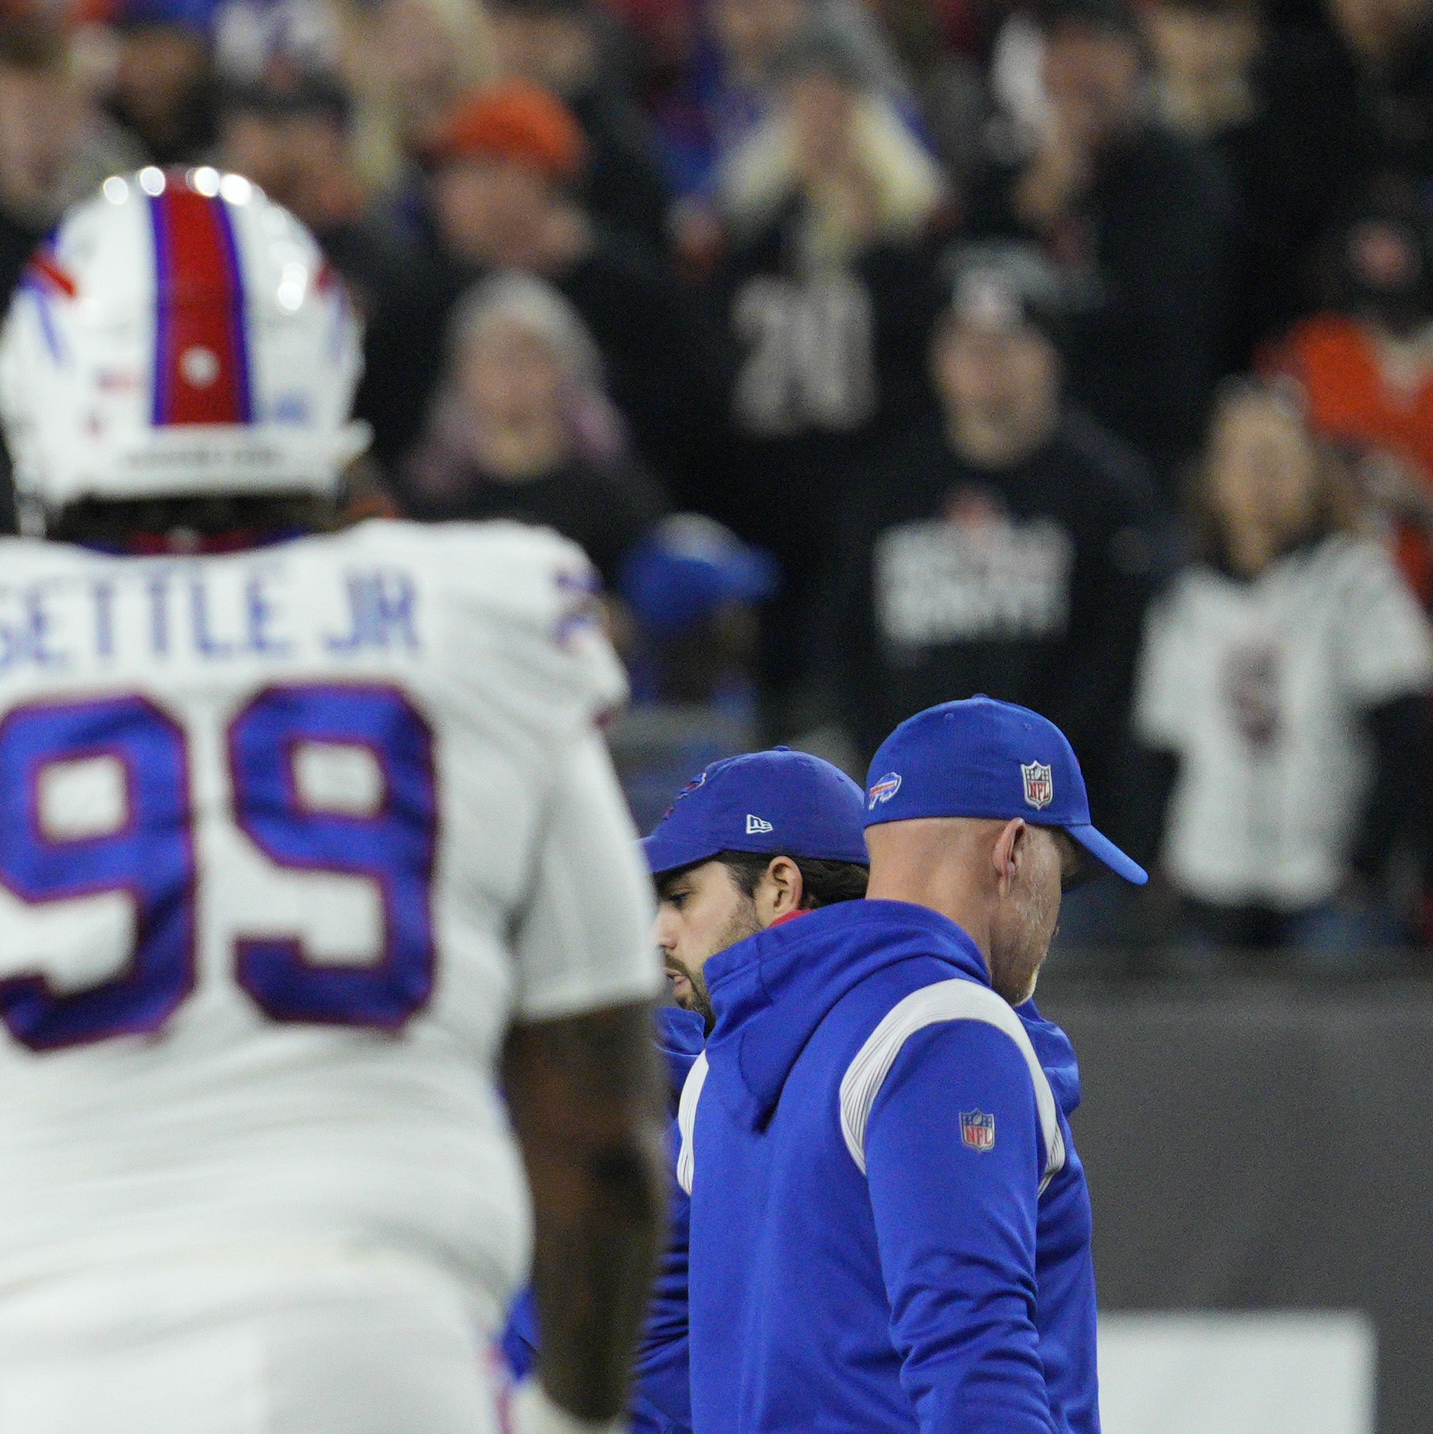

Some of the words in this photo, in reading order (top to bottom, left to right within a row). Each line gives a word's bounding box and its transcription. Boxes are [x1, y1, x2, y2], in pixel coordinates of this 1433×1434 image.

[321, 565, 422, 660] JR
[1028, 781, 1050, 801] NFL
[964, 1126, 992, 1147] NFL
